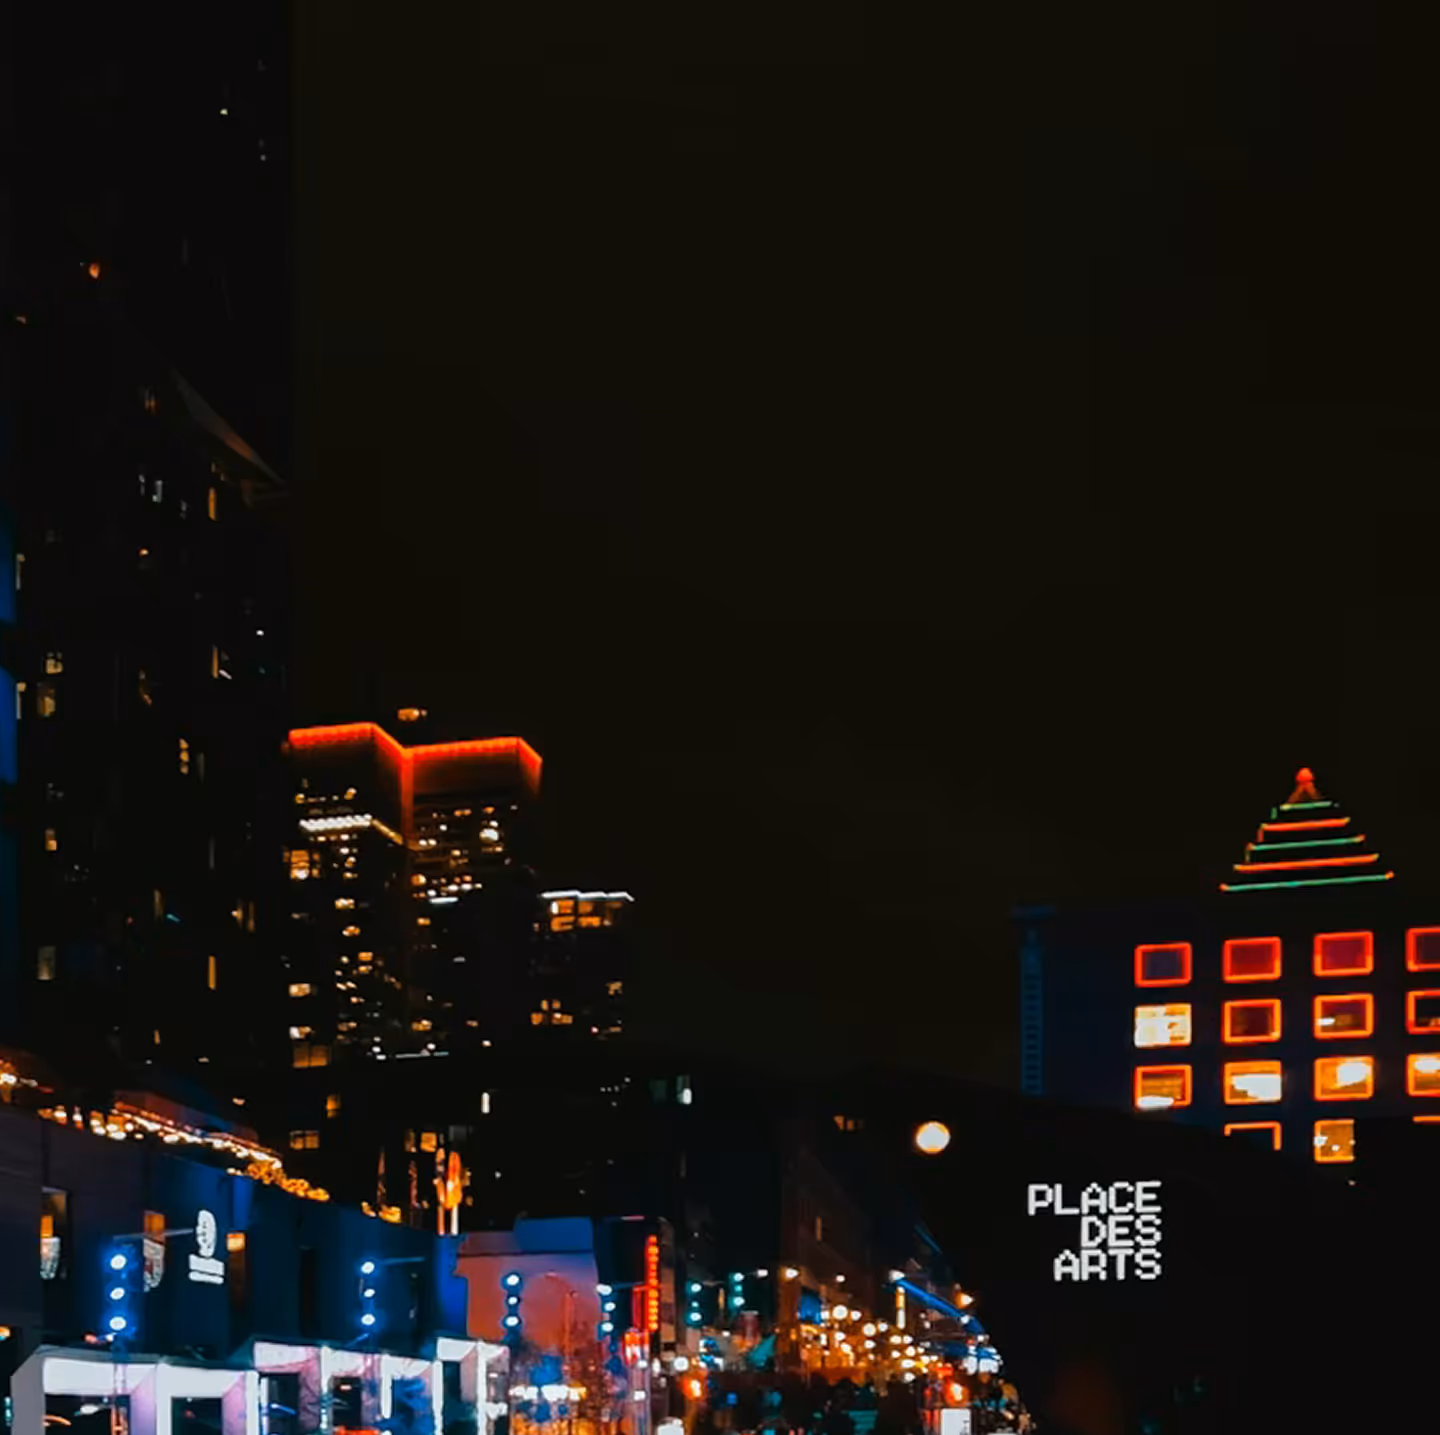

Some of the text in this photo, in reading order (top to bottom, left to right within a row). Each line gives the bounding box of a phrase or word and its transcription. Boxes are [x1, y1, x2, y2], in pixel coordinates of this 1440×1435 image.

[1028, 1180, 1162, 1216] PLACE
[1081, 1215, 1162, 1247] DES
[1054, 1248, 1162, 1281] ARTS
